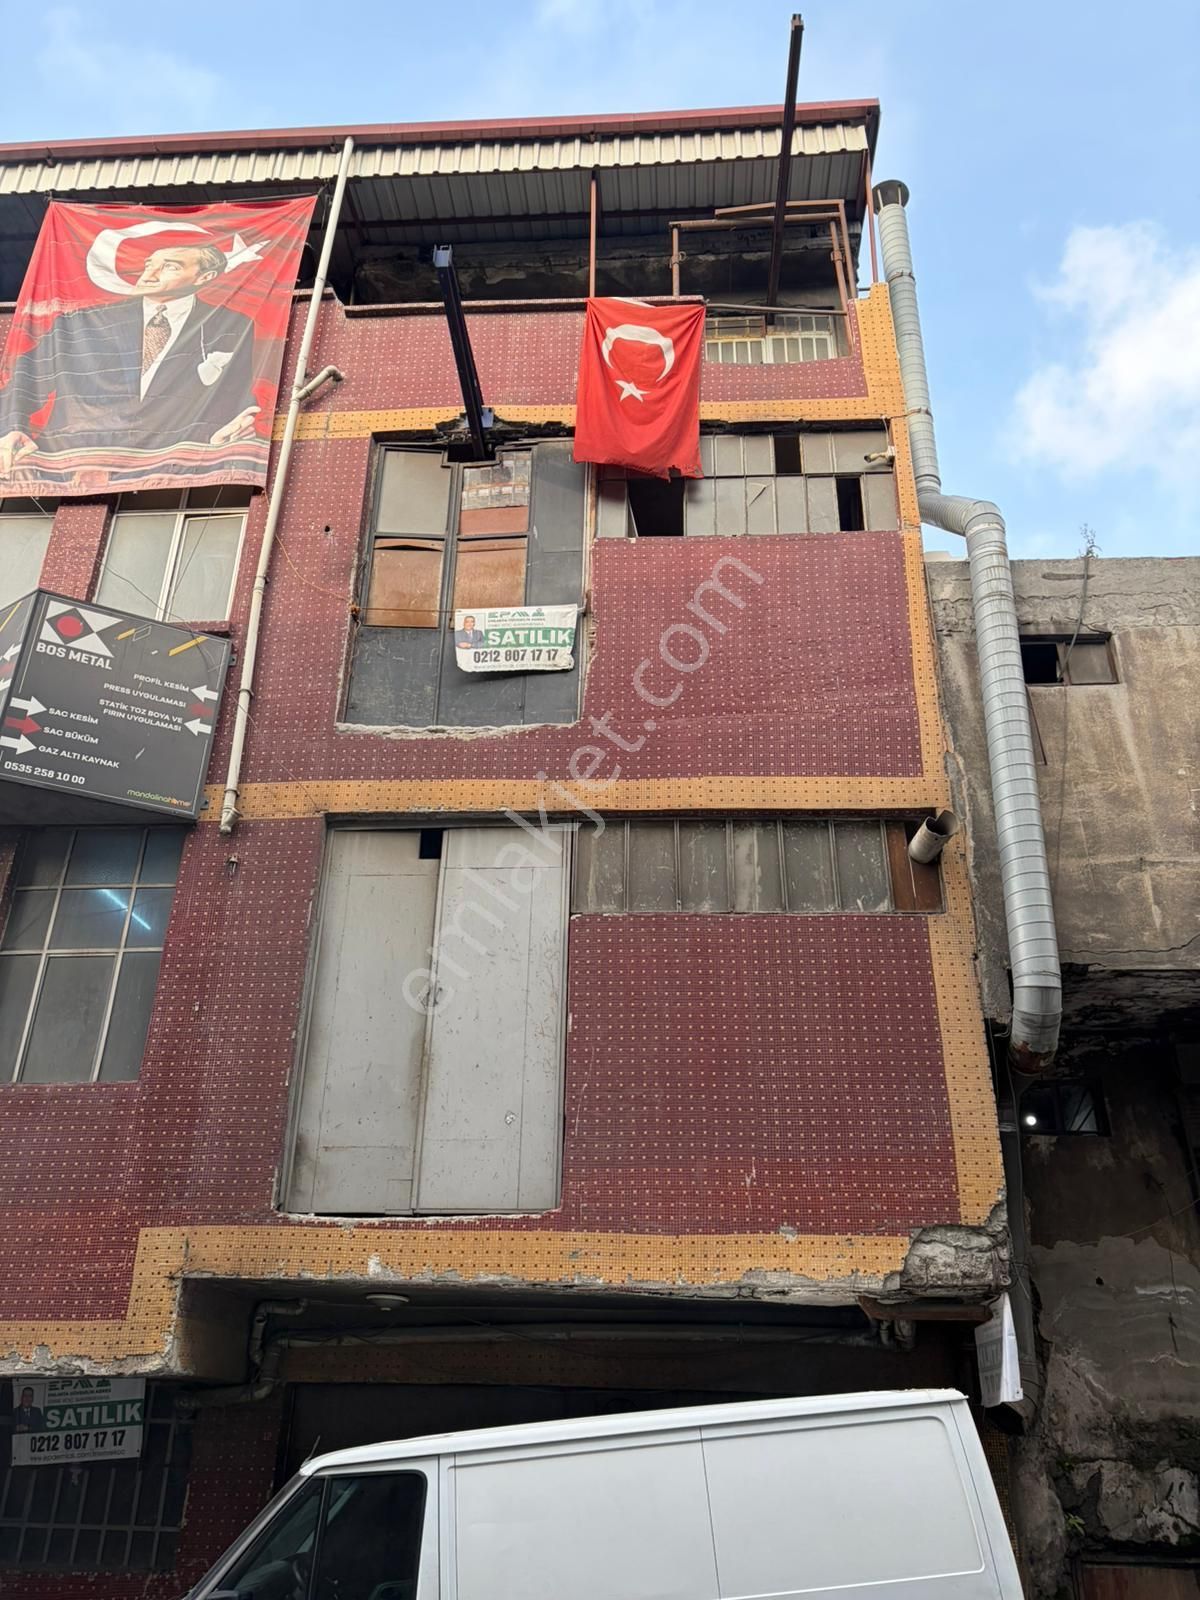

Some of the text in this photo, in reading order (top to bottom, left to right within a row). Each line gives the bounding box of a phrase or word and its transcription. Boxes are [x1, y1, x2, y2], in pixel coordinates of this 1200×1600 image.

[488, 629, 571, 646] SATILIK
[36, 642, 113, 670] BOS METAL
[473, 648, 559, 663] 0212 807 17 17
[103, 683, 131, 694] PRESS
[133, 673, 189, 693] PROFİL KESİM
[48, 707, 98, 725] SAC KESİM
[99, 698, 183, 724] STATİK TOZ BOYA VE
[103, 708, 126, 718] FIRIN
[43, 726, 99, 744] SAC BÜKÜM
[38, 745, 120, 769] GAZ ALTI KAYNAK
[4, 760, 86, 785] 0535 258 10 00
[46, 1403, 142, 1428] SATILIK
[30, 1430, 126, 1453] 0212 807 17 17
